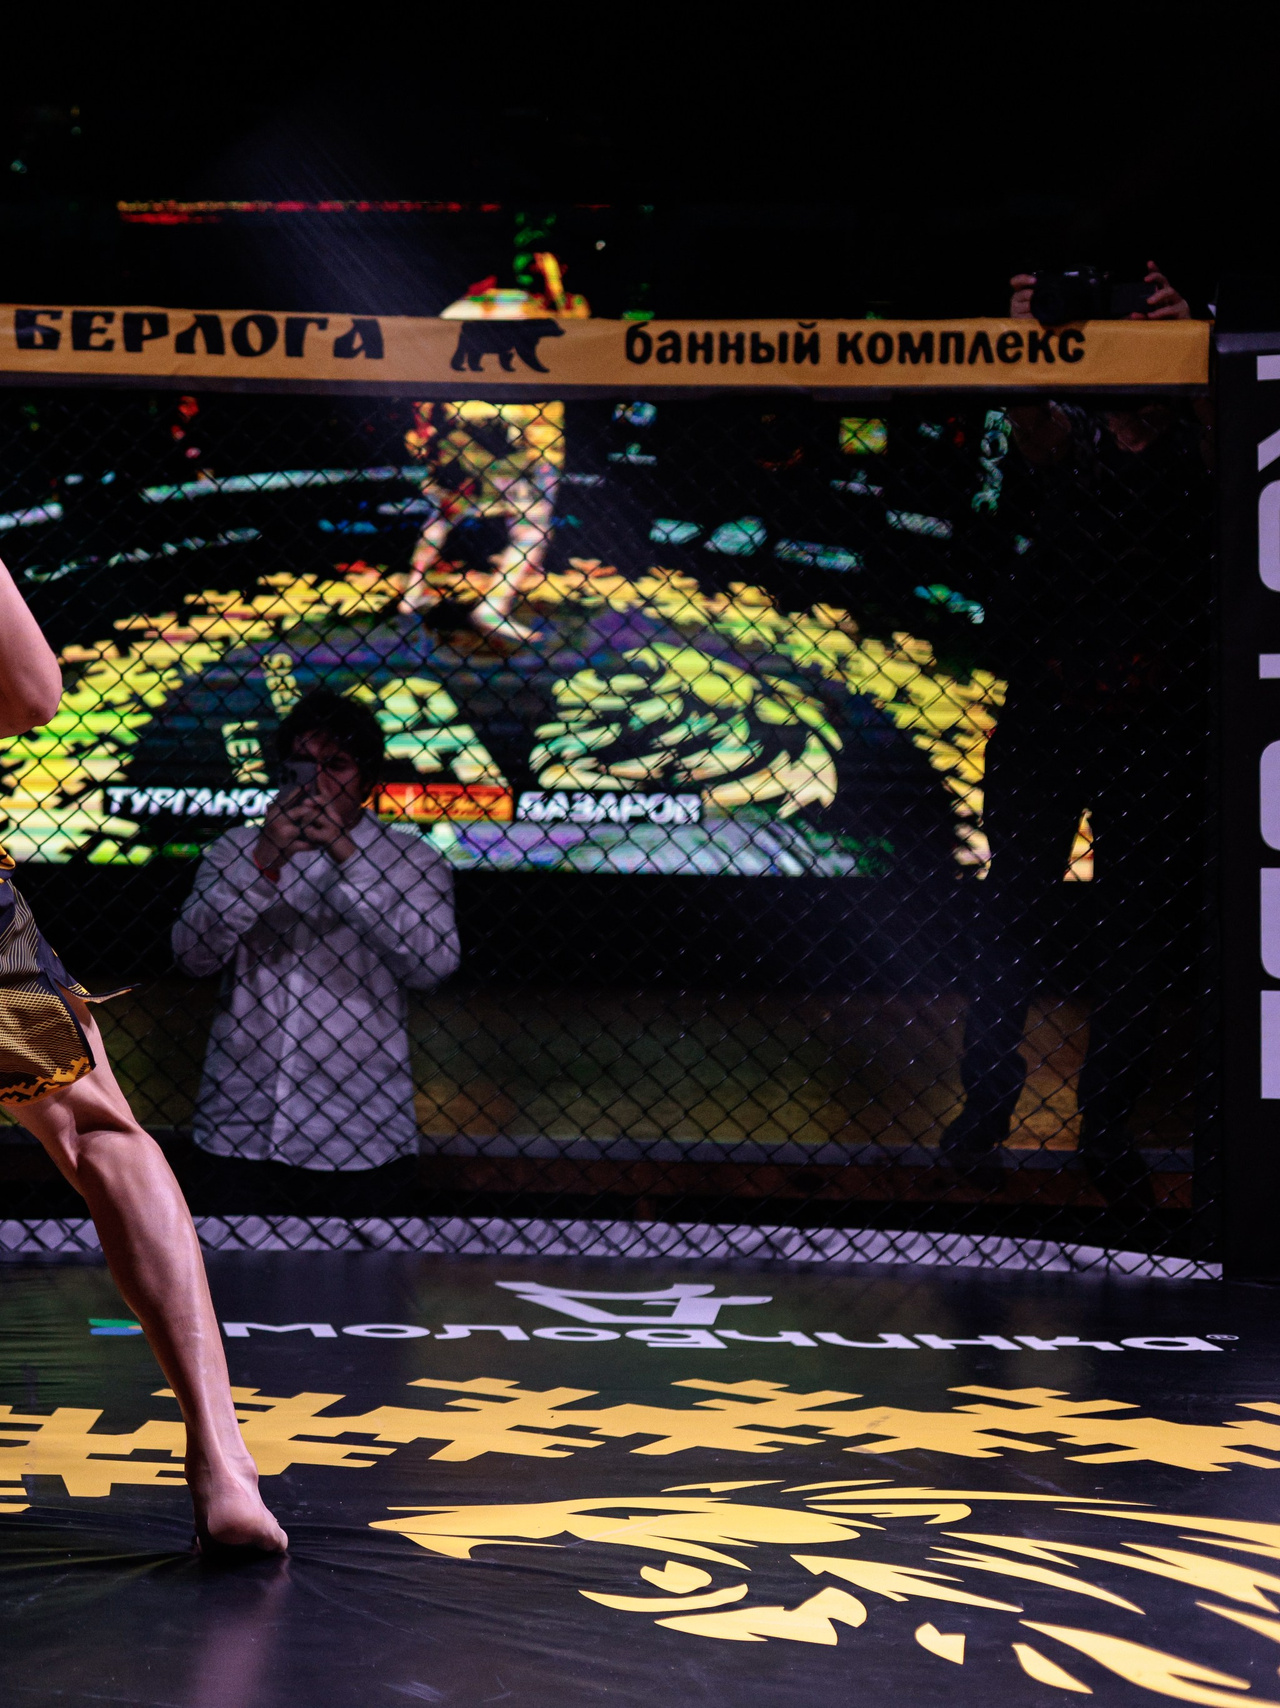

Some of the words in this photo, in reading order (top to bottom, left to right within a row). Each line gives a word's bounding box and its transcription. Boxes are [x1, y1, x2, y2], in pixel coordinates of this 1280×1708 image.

[15, 308, 385, 360] БЕРЛОГА
[625, 322, 820, 365] банный
[837, 326, 1086, 365] комплекс
